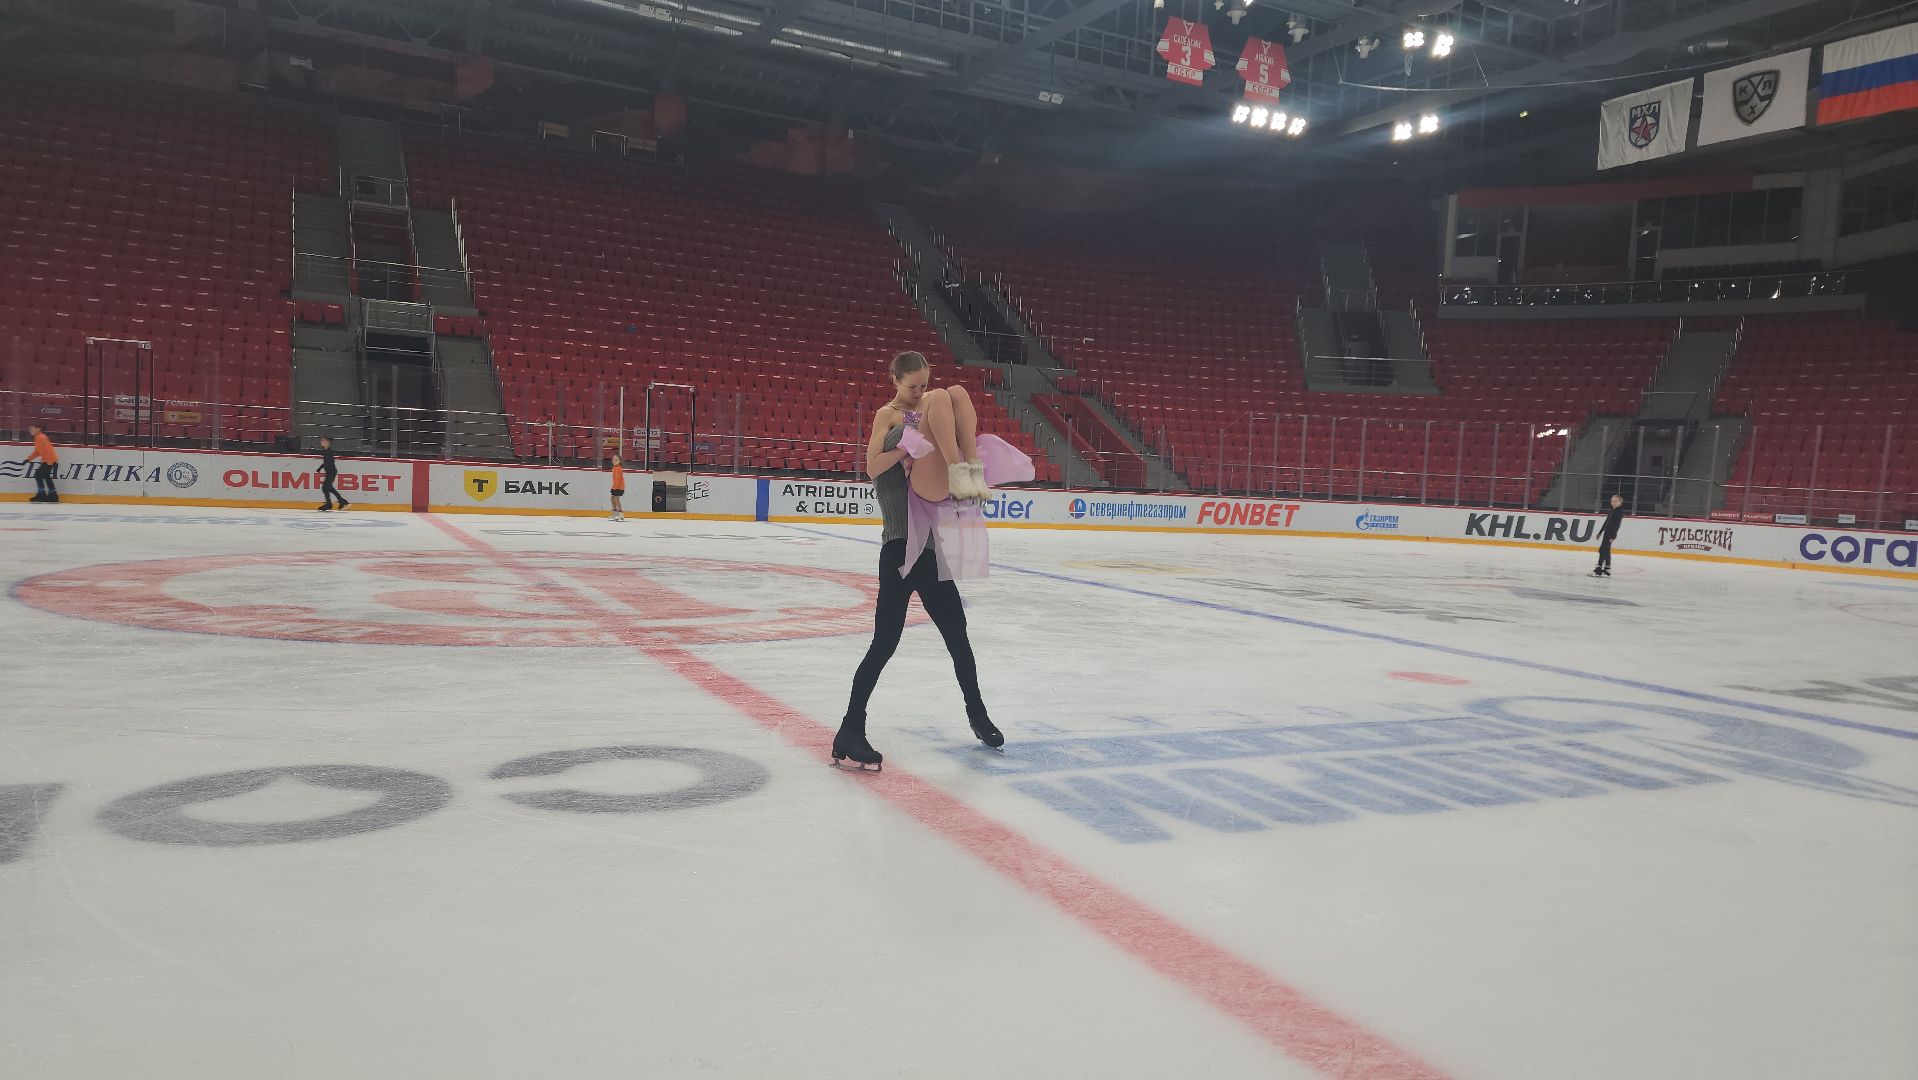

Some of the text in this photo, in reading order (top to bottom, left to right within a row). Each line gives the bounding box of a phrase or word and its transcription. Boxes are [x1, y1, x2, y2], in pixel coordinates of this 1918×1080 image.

[1181, 46, 1191, 66] 3
[1259, 64, 1269, 84] 5
[1631, 102, 1660, 118] МХЛ
[223, 469, 401, 492] OLIMPBET
[504, 480, 570, 496] БАНК
[781, 484, 878, 500] ATRIBUTIK
[795, 501, 808, 513] &
[814, 502, 859, 515] CLUB
[1197, 502, 1300, 527] FONBET
[1465, 512, 1596, 543] KHL.RU
[1658, 526, 1733, 551] ТУЛЬСКИЙ
